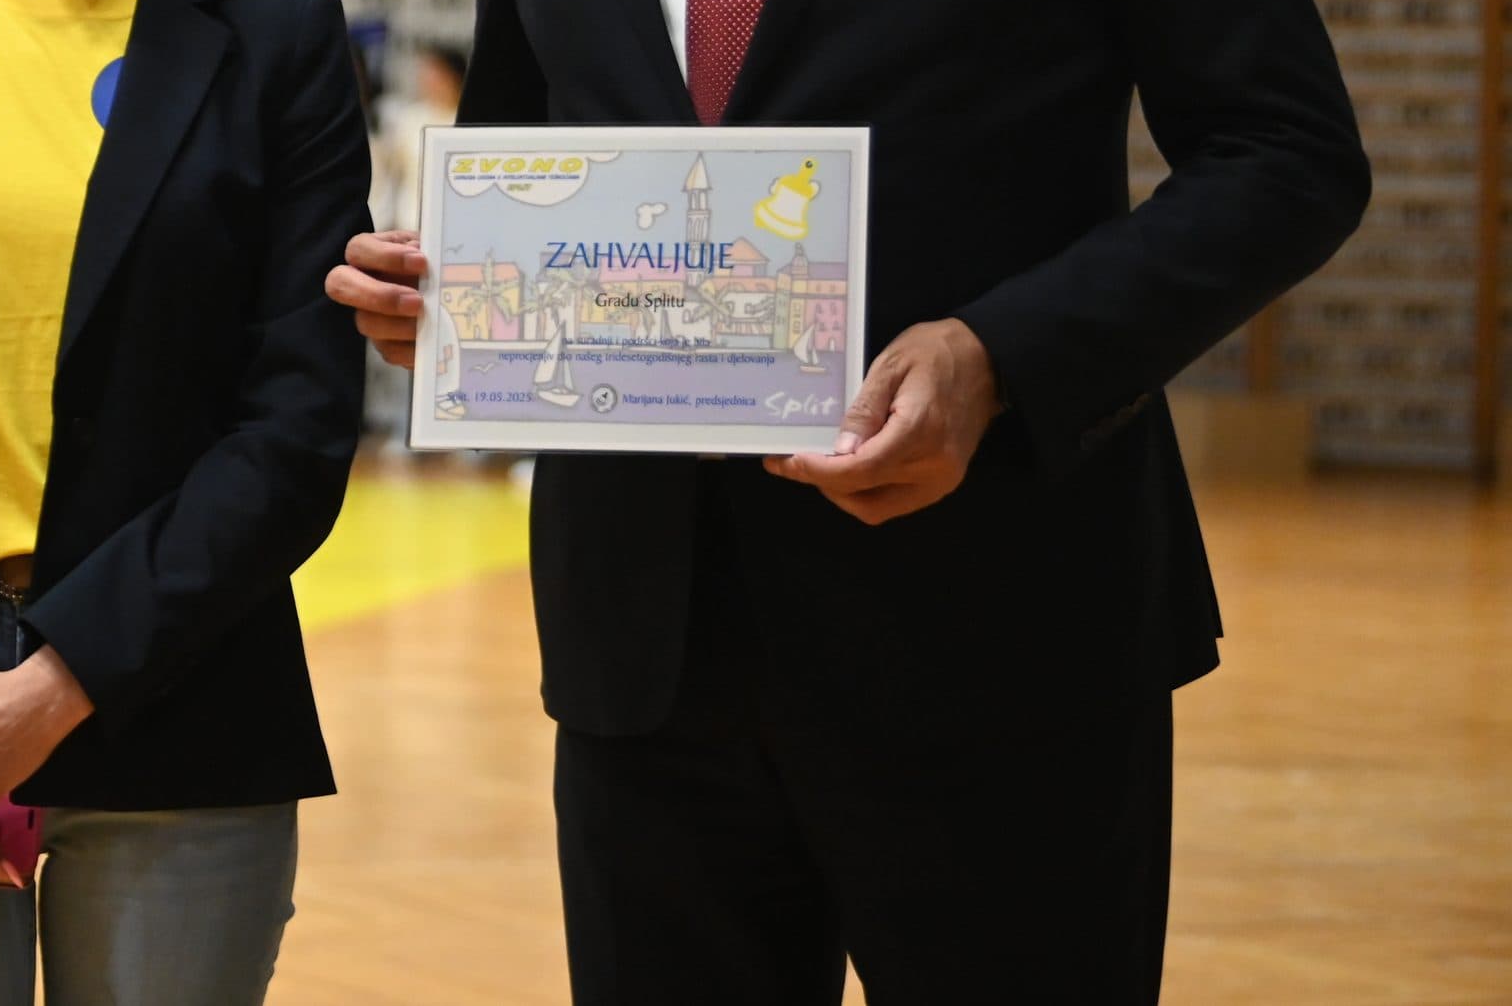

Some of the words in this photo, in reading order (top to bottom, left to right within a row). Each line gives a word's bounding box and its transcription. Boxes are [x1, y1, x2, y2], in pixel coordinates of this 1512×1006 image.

[453, 157, 583, 173] ZVONO
[544, 241, 735, 274] ZAHVALJUJE
[595, 293, 638, 308] Gradu
[644, 293, 686, 313] Splitu
[764, 392, 838, 419] Split
